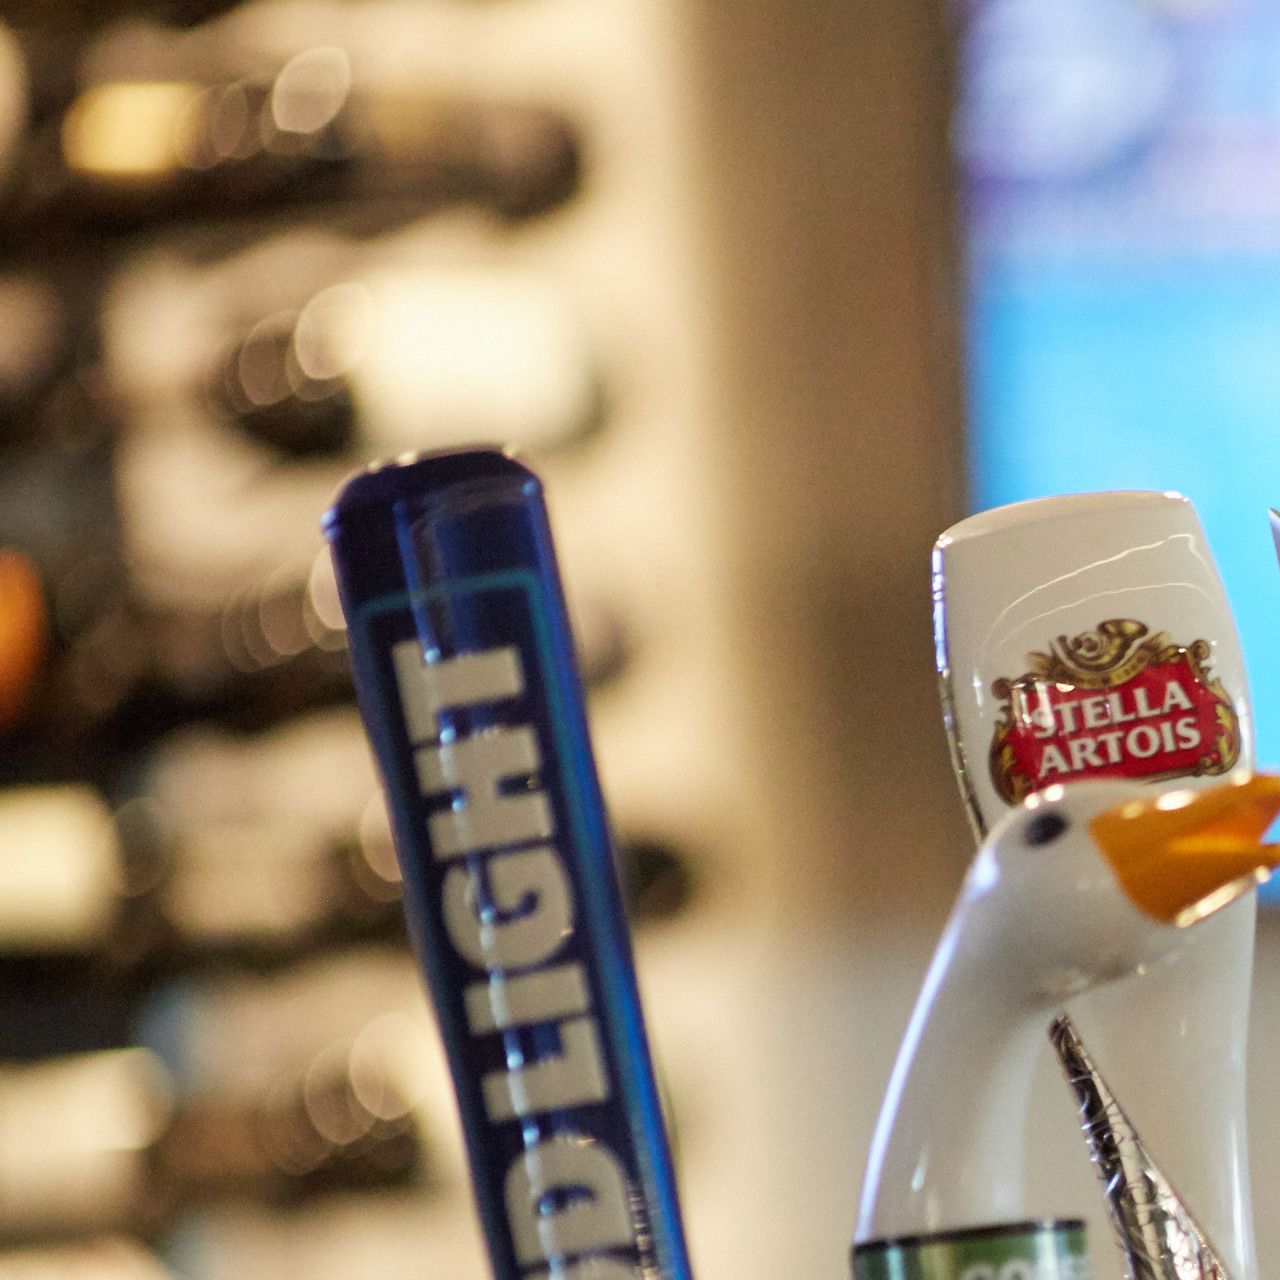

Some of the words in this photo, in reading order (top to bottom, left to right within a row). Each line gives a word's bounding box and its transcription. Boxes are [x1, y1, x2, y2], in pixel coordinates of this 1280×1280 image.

[1031, 680, 1195, 740] STELLA
[1037, 716, 1202, 779] ARTOIS
[392, 636, 612, 1124] LIGHT
